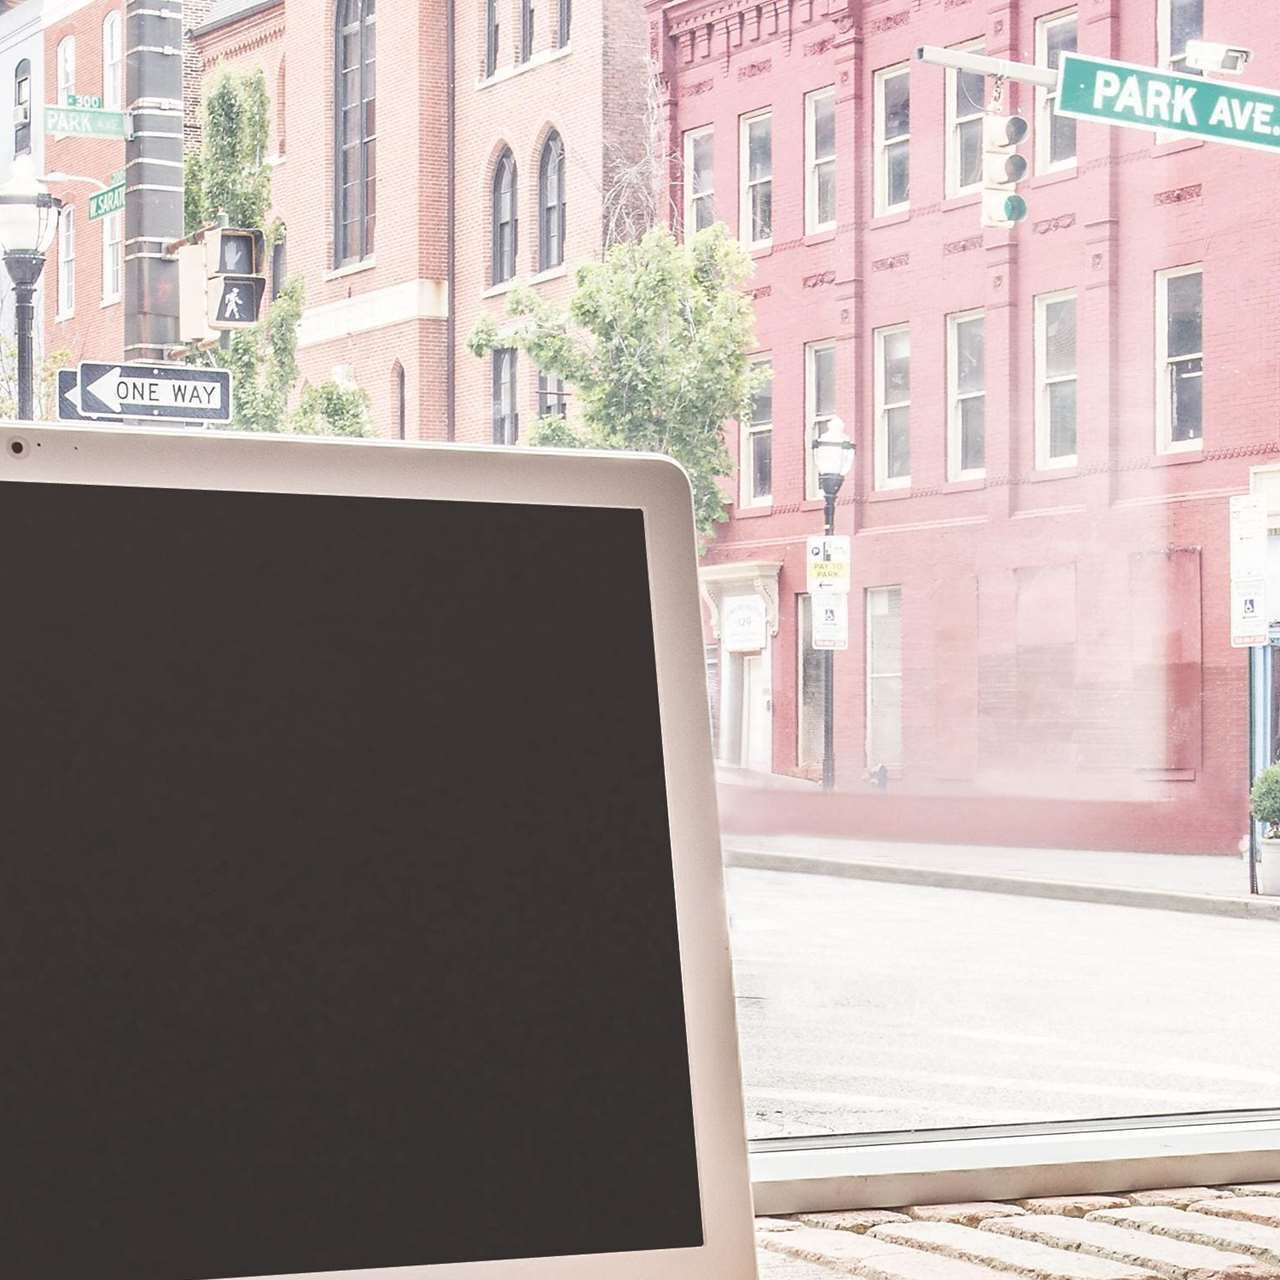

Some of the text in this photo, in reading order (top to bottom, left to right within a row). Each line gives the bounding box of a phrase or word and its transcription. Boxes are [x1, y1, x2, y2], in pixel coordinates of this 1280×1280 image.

[75, 95, 101, 109] 300
[1091, 70, 1198, 127] PARK
[47, 111, 93, 132] PARK
[116, 381, 216, 404] ONE WAY
